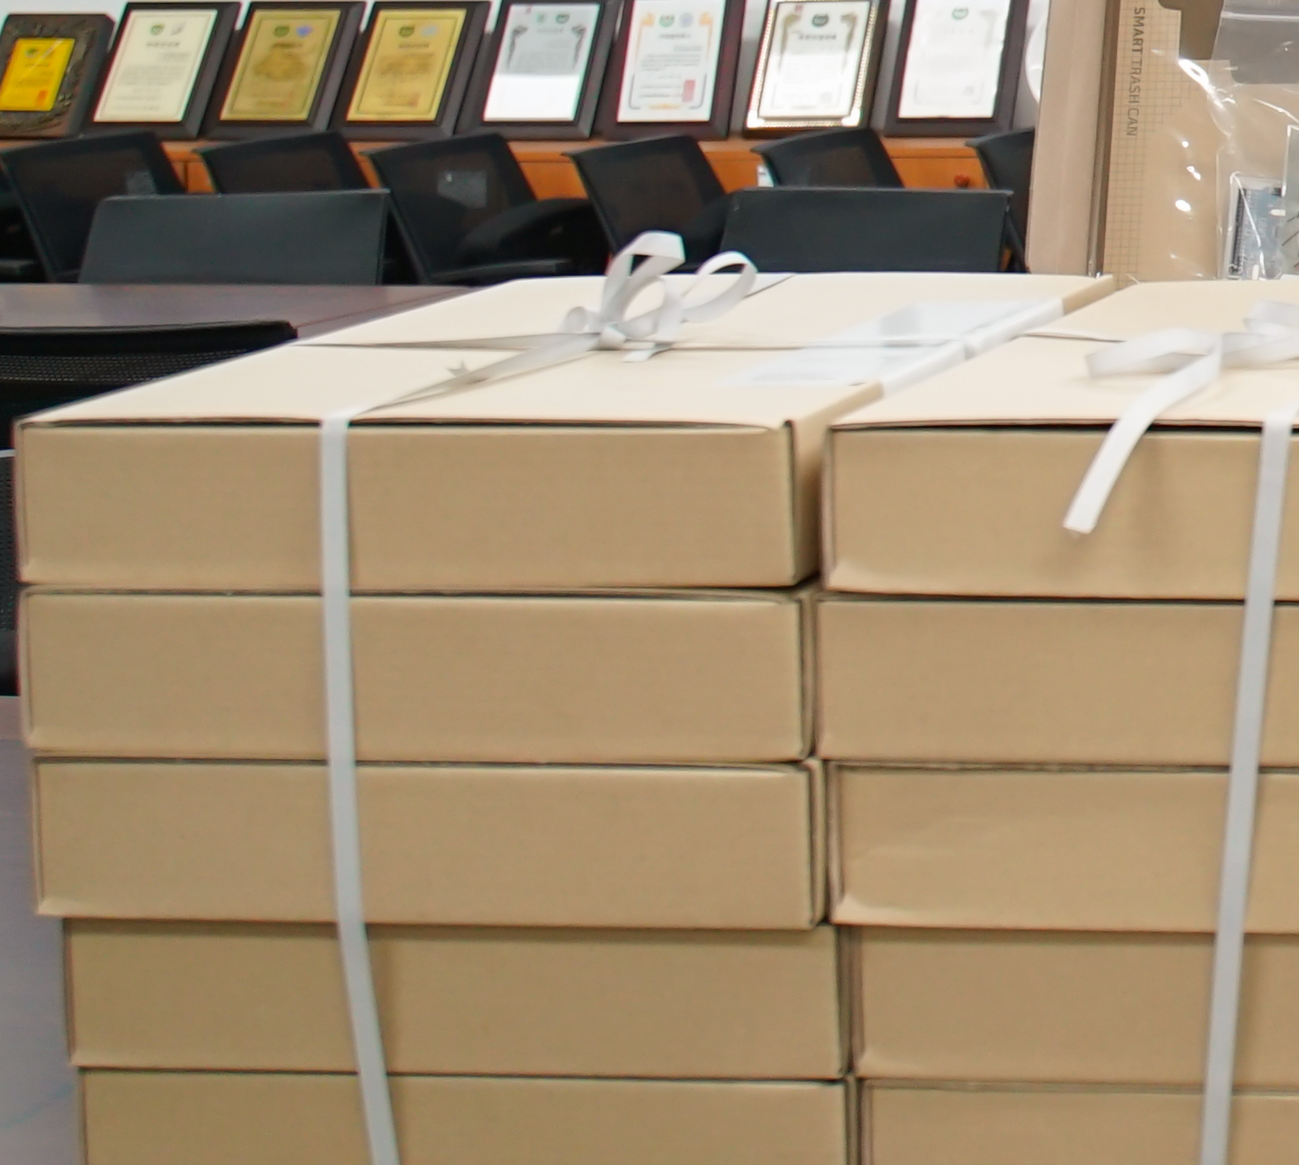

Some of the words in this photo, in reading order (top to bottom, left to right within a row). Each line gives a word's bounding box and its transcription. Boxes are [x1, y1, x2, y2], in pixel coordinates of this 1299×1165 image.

[1131, 7, 1146, 55] SMART
[1129, 58, 1143, 103] TRASH
[1126, 107, 1140, 137] CAN
